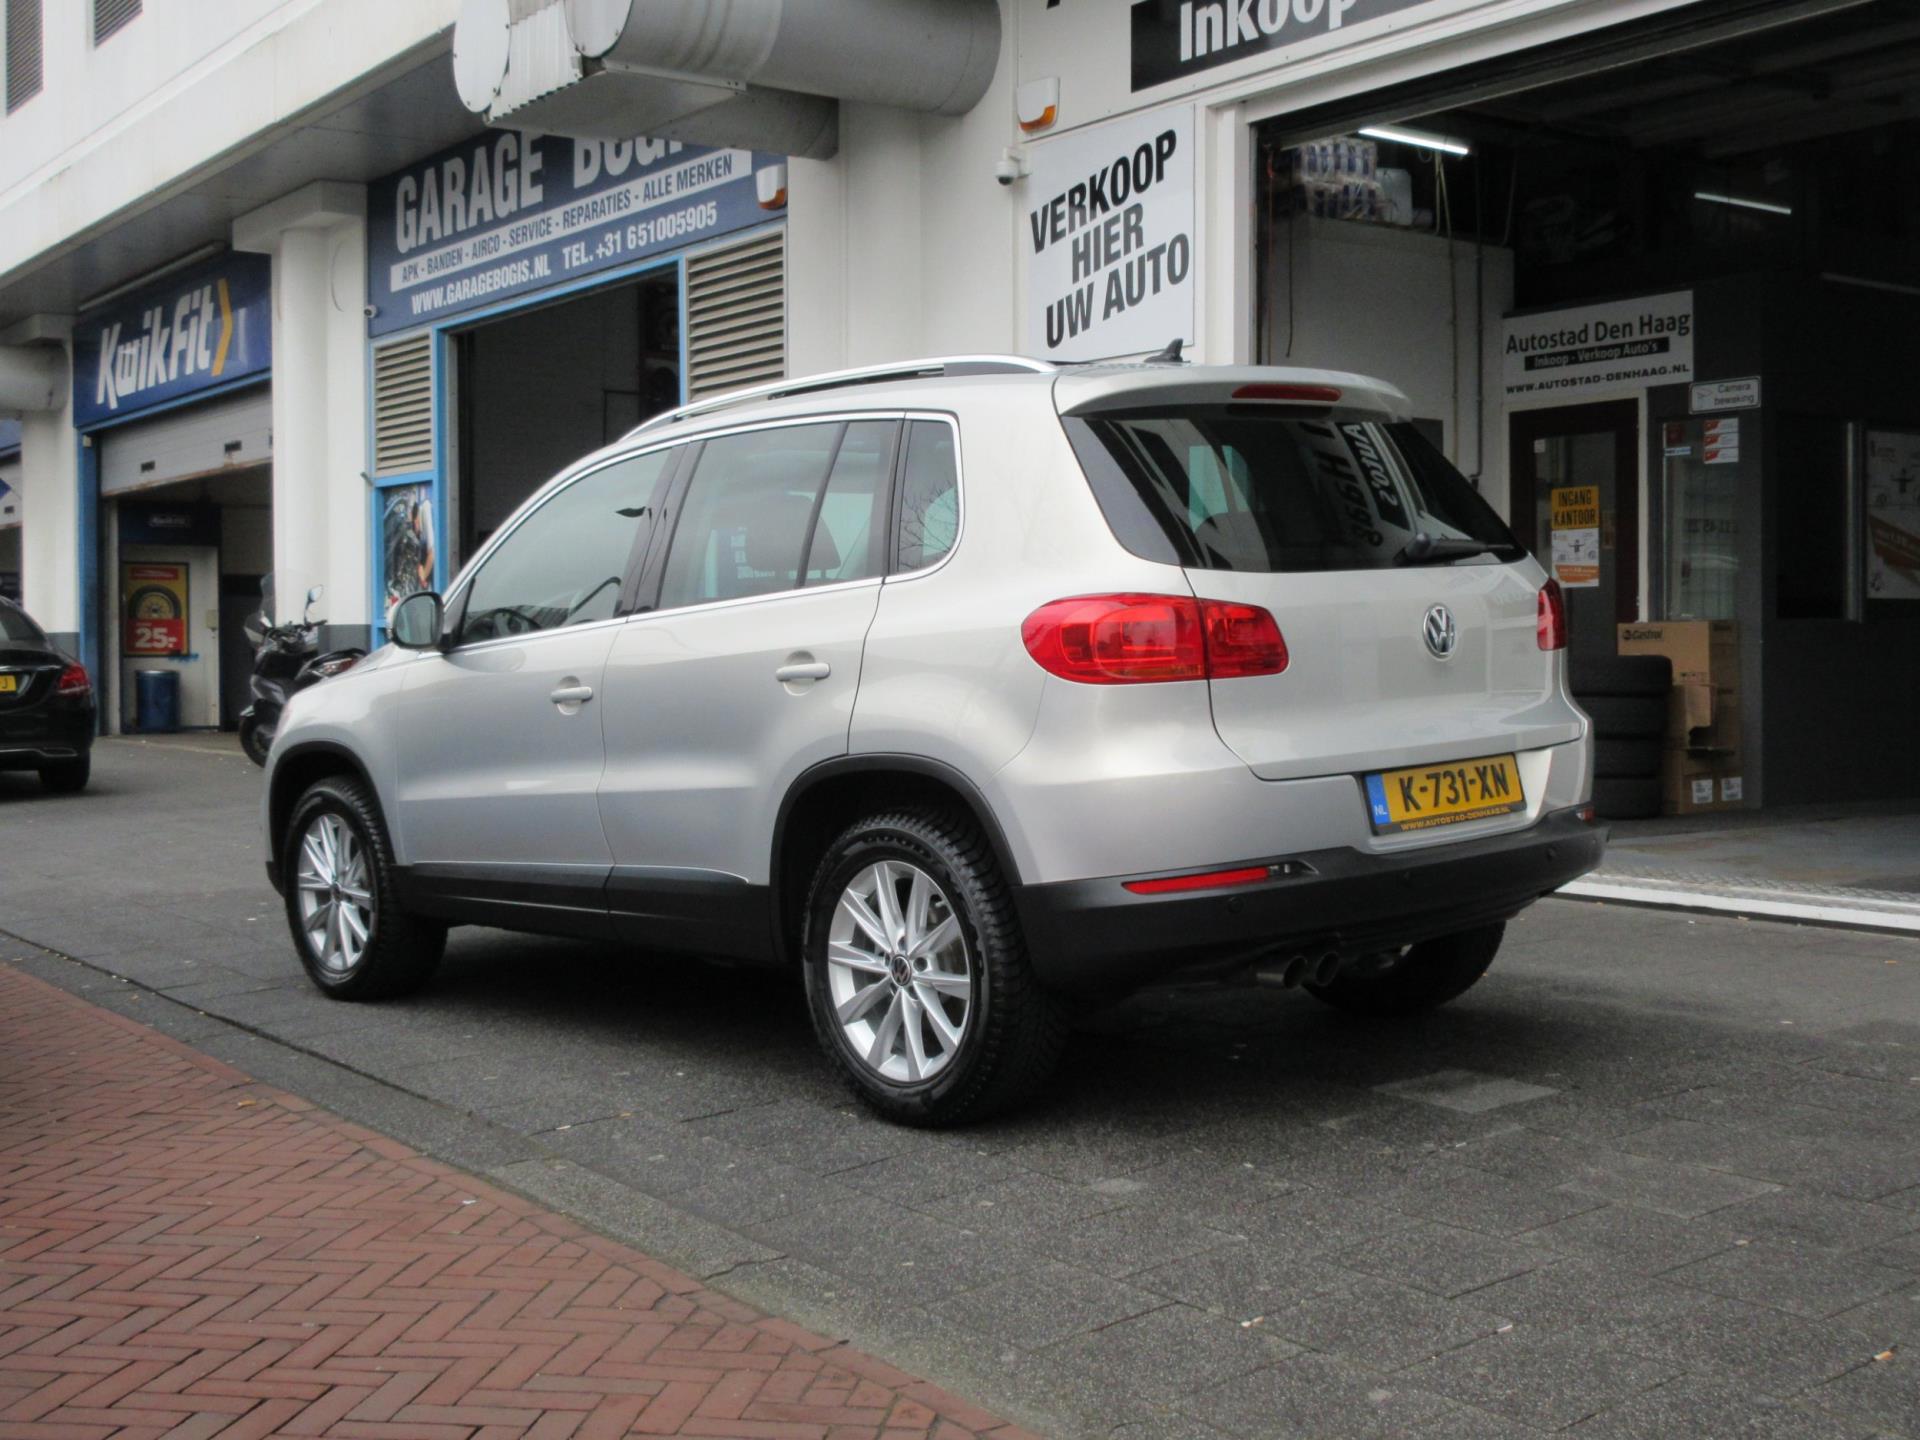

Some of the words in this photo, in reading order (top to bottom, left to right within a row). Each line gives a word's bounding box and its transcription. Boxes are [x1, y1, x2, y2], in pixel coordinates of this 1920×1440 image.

[396, 131, 543, 254] GARAGE
[402, 261, 419, 283] APK
[427, 247, 463, 275] BANDEN
[471, 235, 500, 260] AIRCO
[509, 217, 552, 247] SERVICE
[563, 189, 631, 230] REPARATIES
[643, 174, 672, 203] ALLE
[676, 154, 732, 192] MERKEN
[1030, 129, 1177, 254] VERKOOP
[412, 255, 551, 314] WWW.GARAGEBOGIS.NL
[562, 241, 593, 269] TEL.
[627, 202, 717, 250] 651005905
[1072, 203, 1144, 284] HIER
[1046, 283, 1094, 349] UW
[1103, 233, 1190, 321] AUTO
[1506, 323, 1588, 354] Autostad
[1595, 321, 1632, 342] Den
[1639, 314, 1690, 336] Haag
[1534, 353, 1568, 369] Inkoop
[1577, 346, 1621, 363] Verkoop
[1506, 364, 1690, 394] WWW.AUTOSTAD-DENHAAG.NL
[1374, 805, 1387, 816] NL
[1398, 763, 1510, 813] K-731-XN
